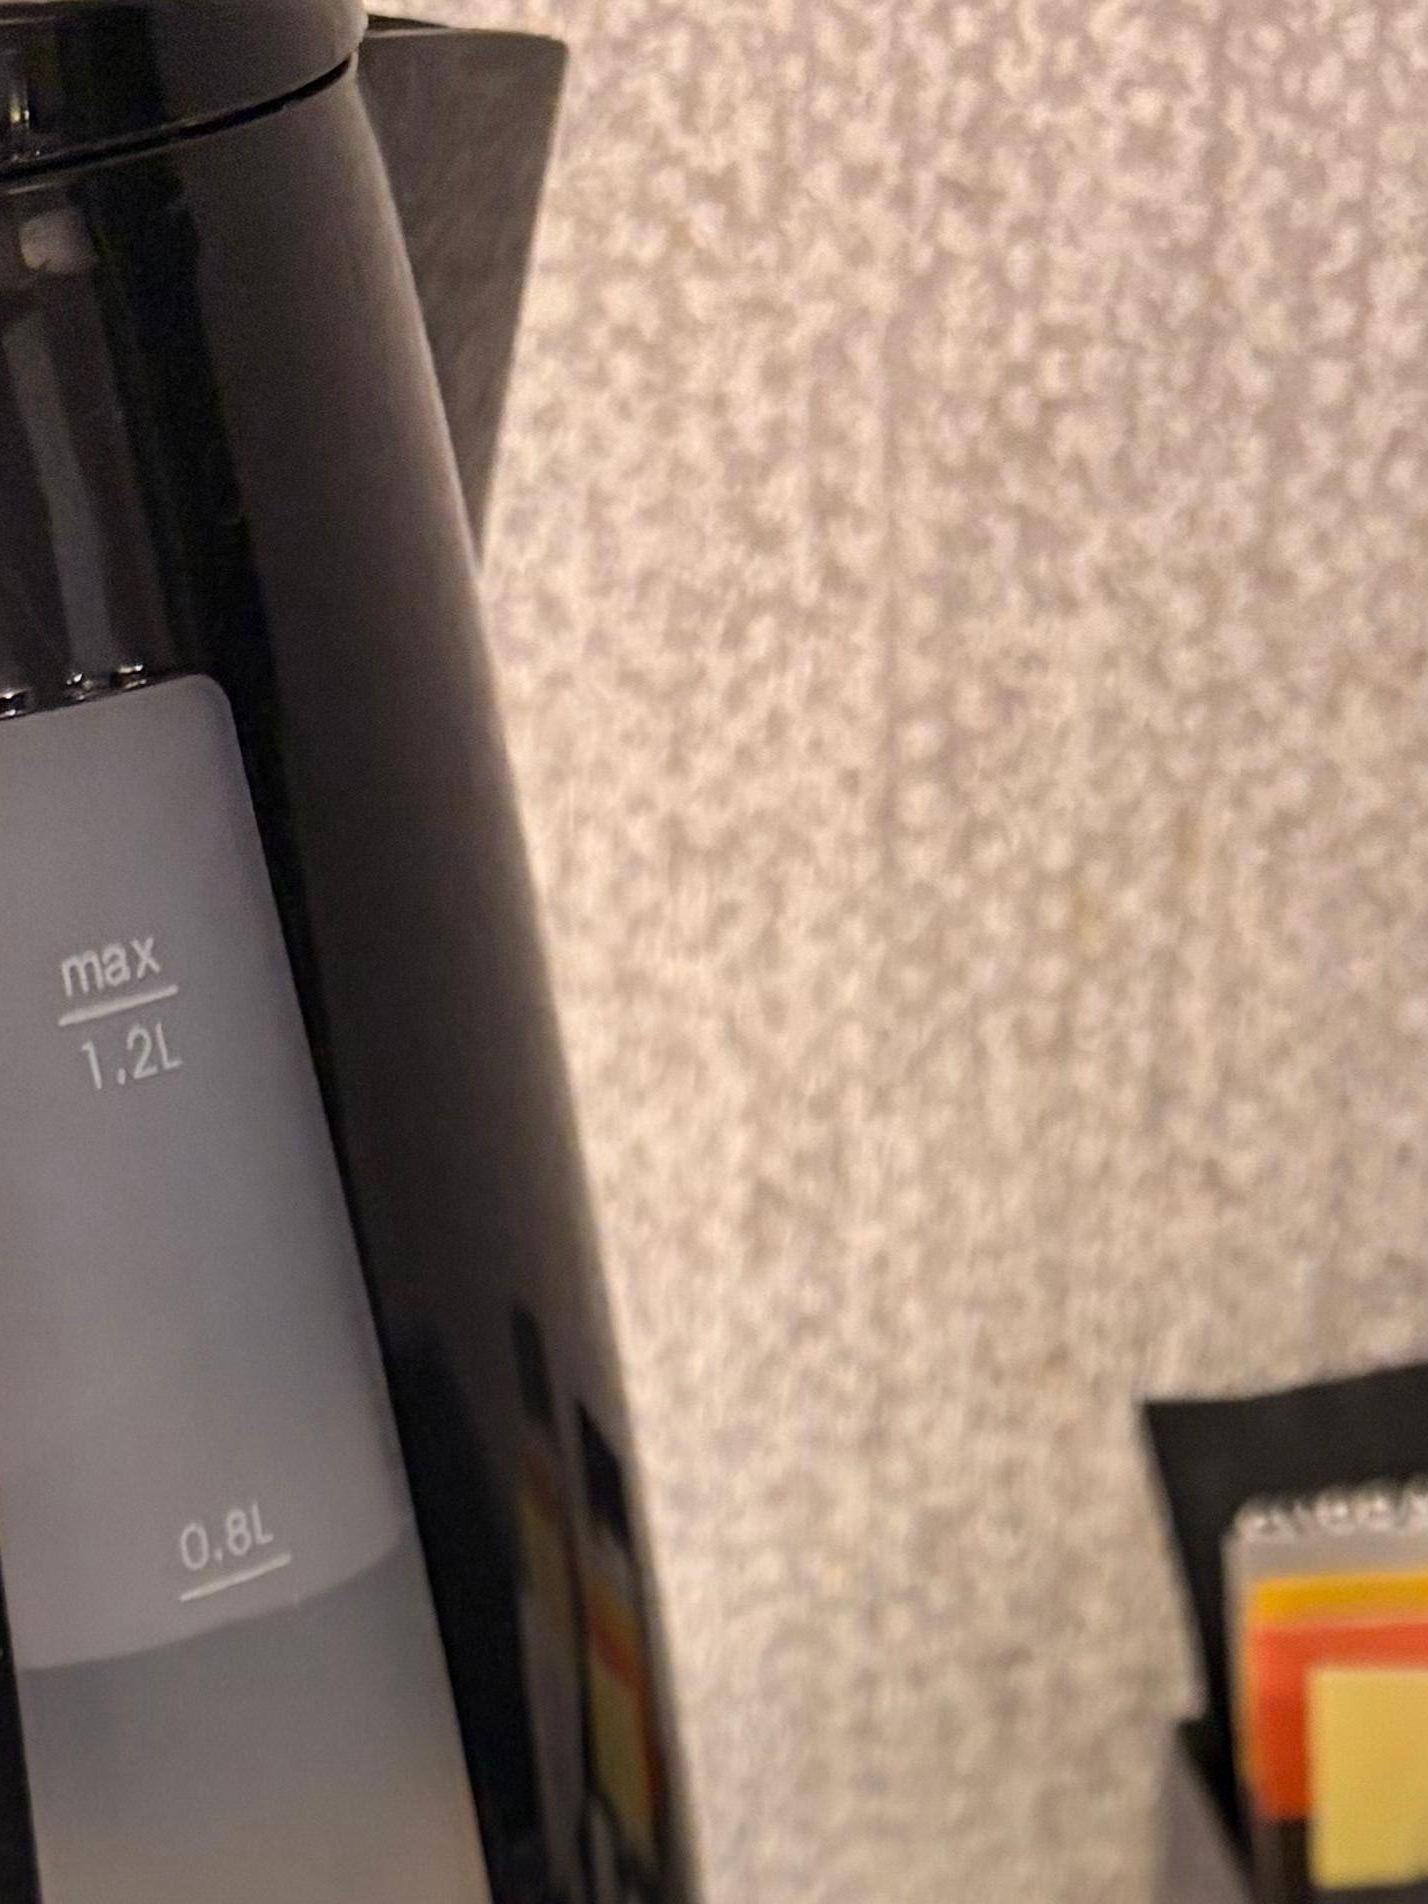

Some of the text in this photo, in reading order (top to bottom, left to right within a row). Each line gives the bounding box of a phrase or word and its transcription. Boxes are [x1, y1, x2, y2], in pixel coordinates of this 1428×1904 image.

[60, 934, 161, 995] max
[78, 1022, 182, 1091] 1.2L
[180, 1502, 274, 1573] 0.8L
